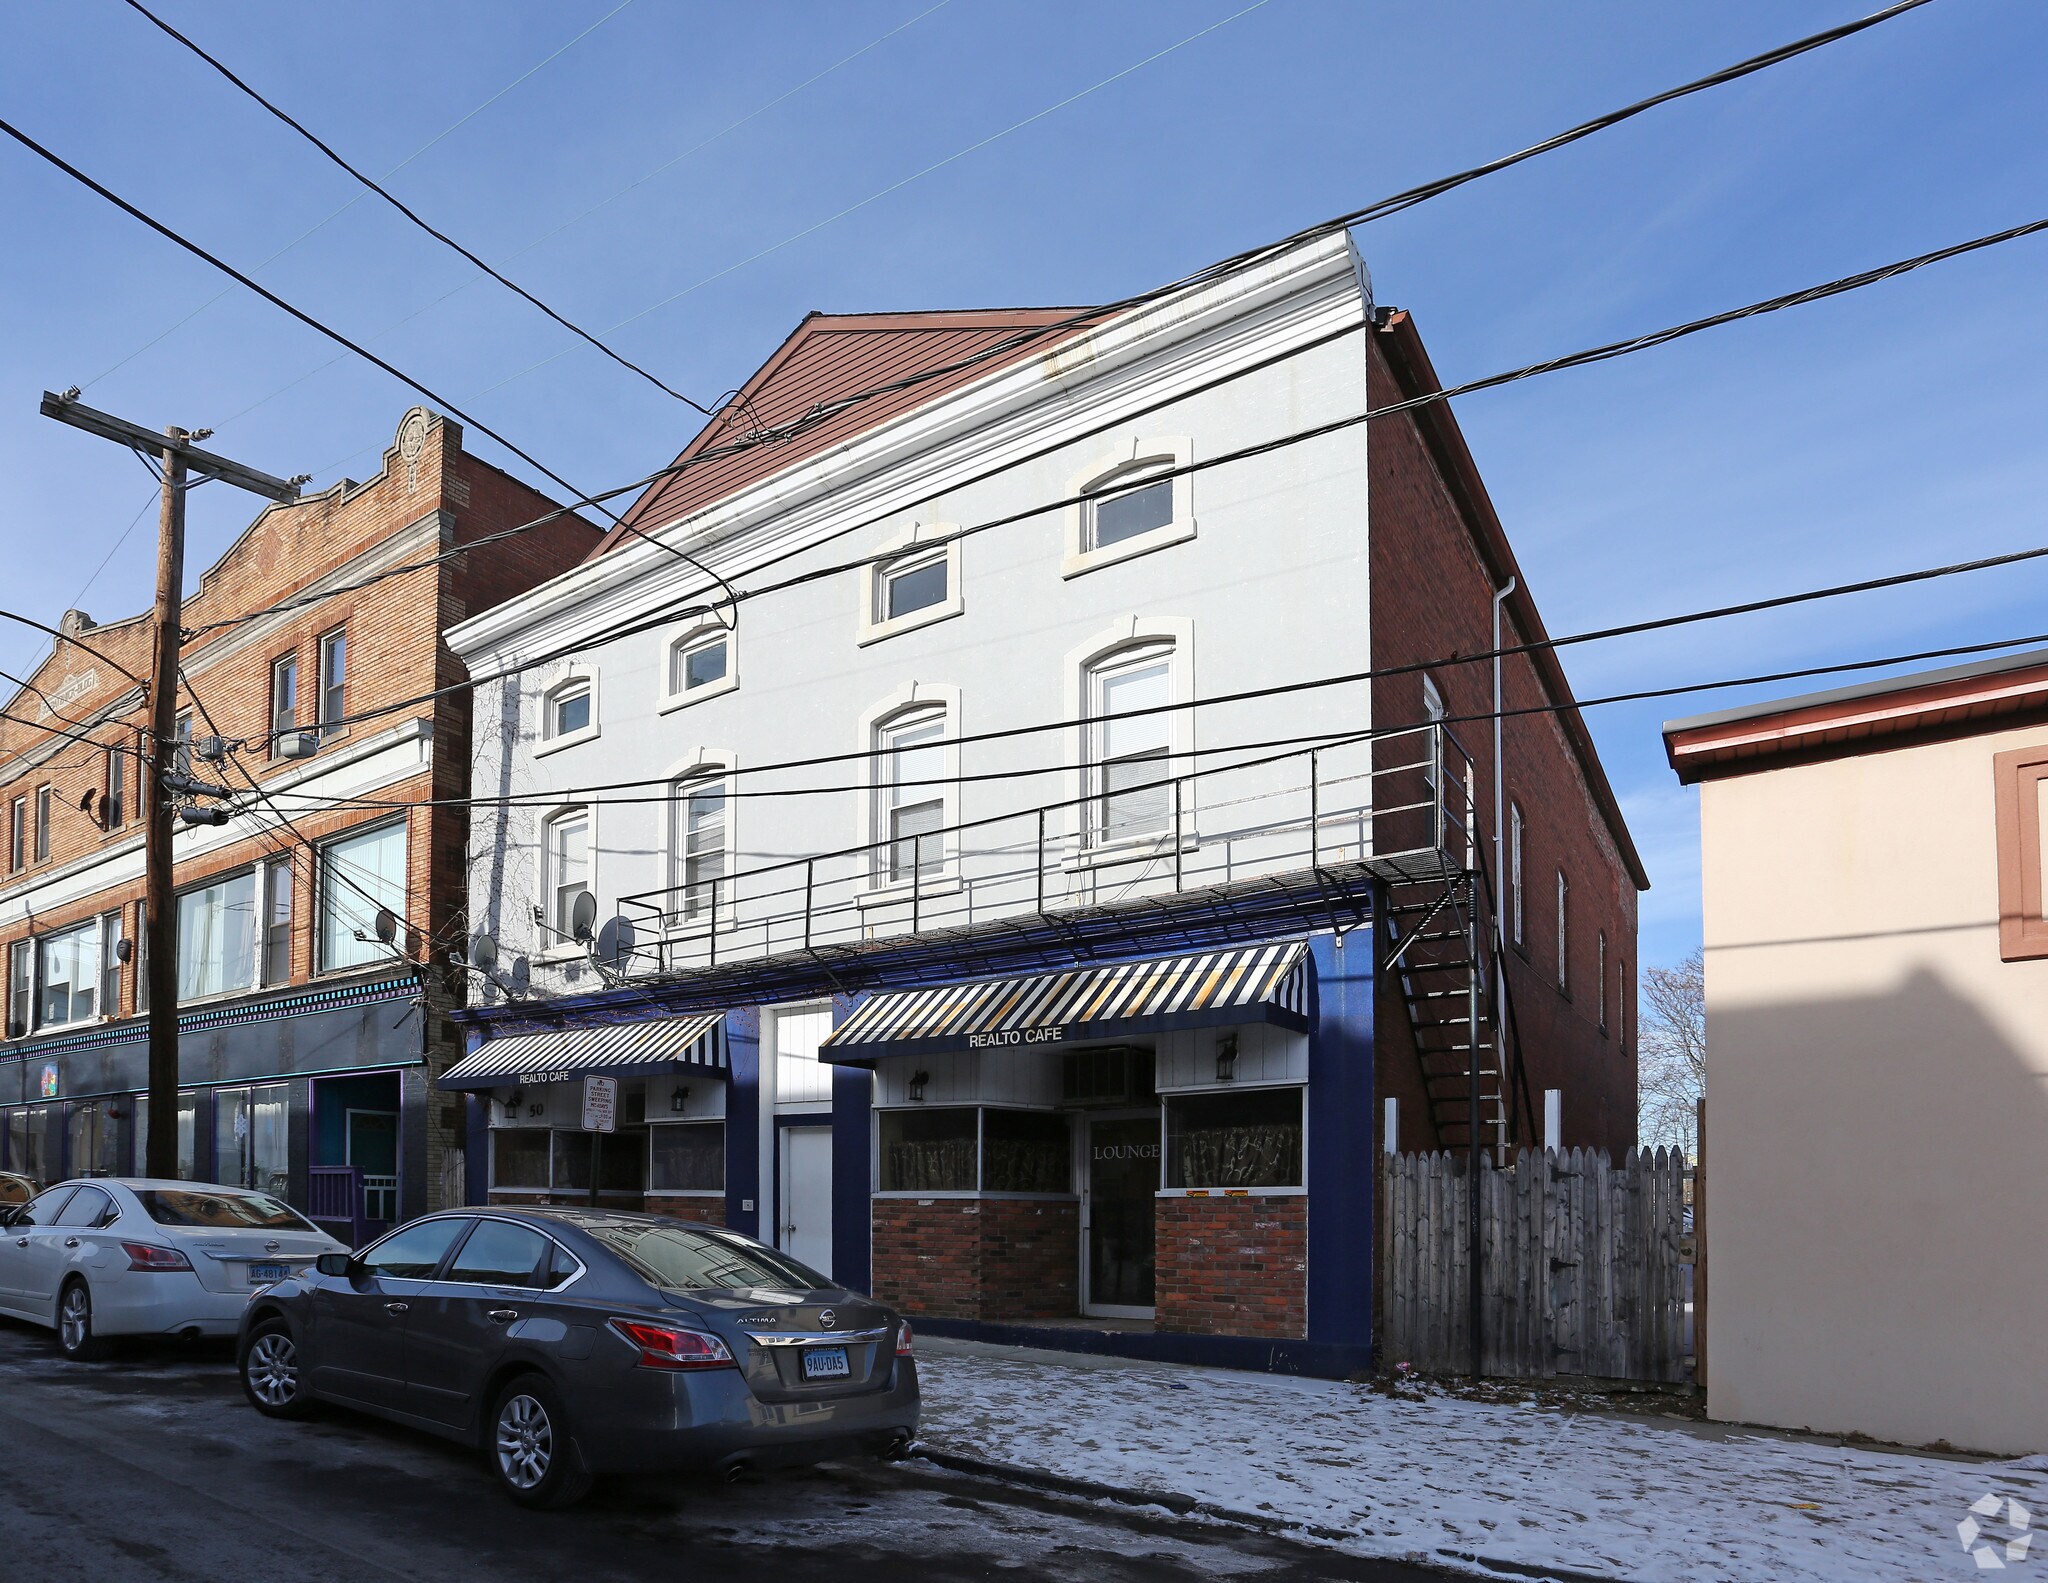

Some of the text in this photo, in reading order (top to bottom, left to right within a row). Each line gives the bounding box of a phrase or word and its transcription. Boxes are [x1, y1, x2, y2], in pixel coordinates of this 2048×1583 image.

[968, 1027, 1062, 1048] REALTO CAFE
[519, 1070, 569, 1084] REALTO CAFE
[529, 1103, 544, 1117] 50
[1092, 1144, 1161, 1160] LOUNGE
